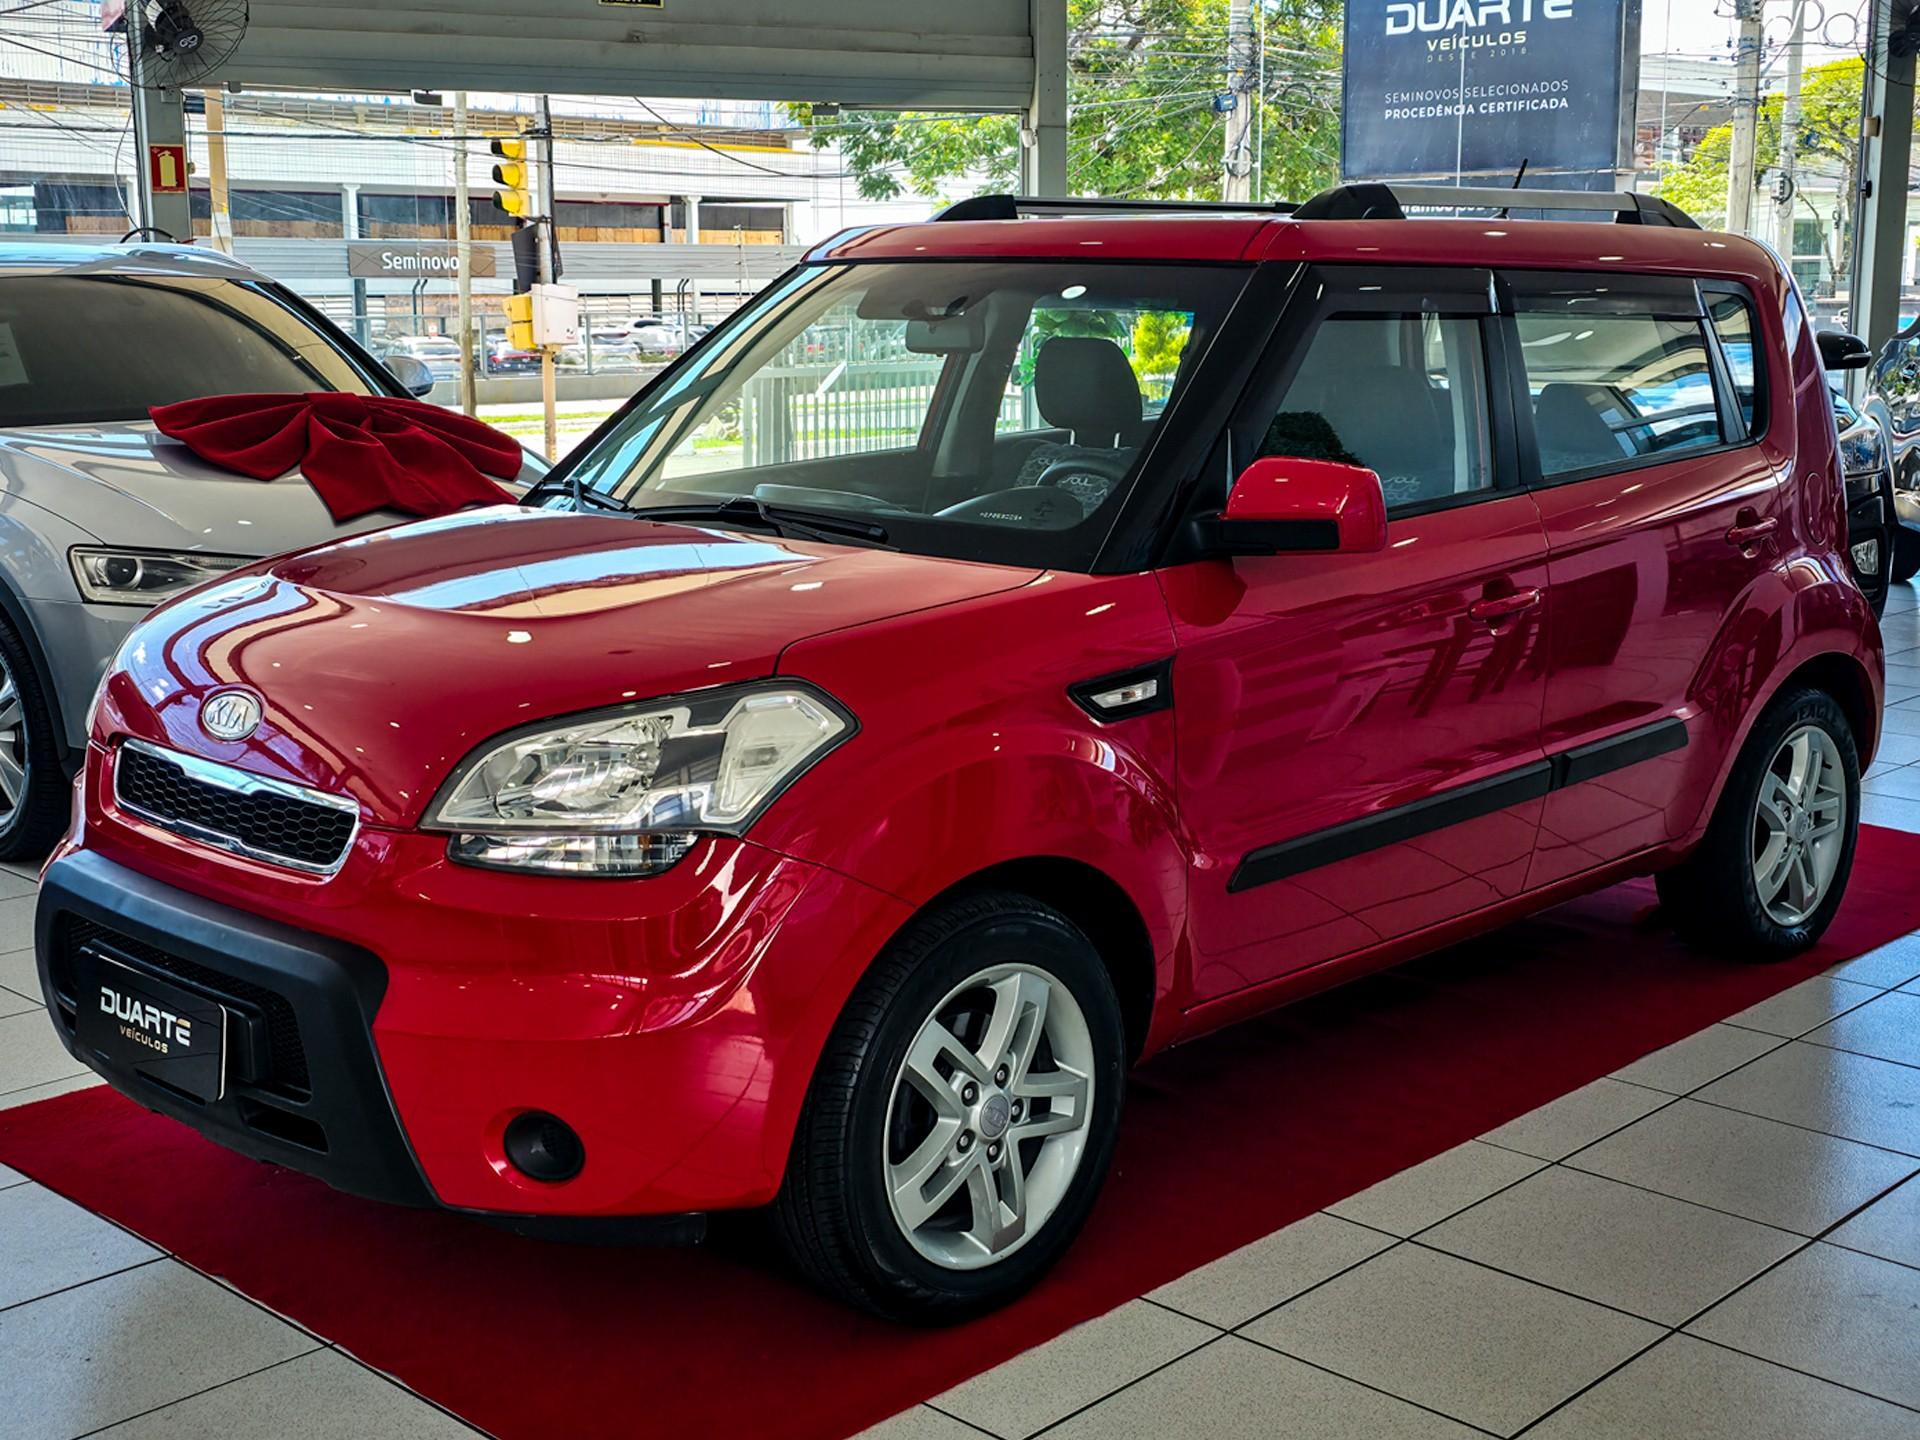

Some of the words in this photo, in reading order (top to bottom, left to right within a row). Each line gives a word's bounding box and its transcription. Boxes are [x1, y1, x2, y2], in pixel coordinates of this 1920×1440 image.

[1427, 31, 1527, 51] VEÍCULOS
[1385, 87, 1460, 104] SEMINOVOS
[1464, 80, 1569, 98] SELECIONADOS
[1385, 103, 1475, 120] PROCEDÊNCIA
[1479, 97, 1569, 114] CERTIFICADA
[101, 986, 191, 1047] DUARTE
[119, 1024, 169, 1054] VEÍCULOS
